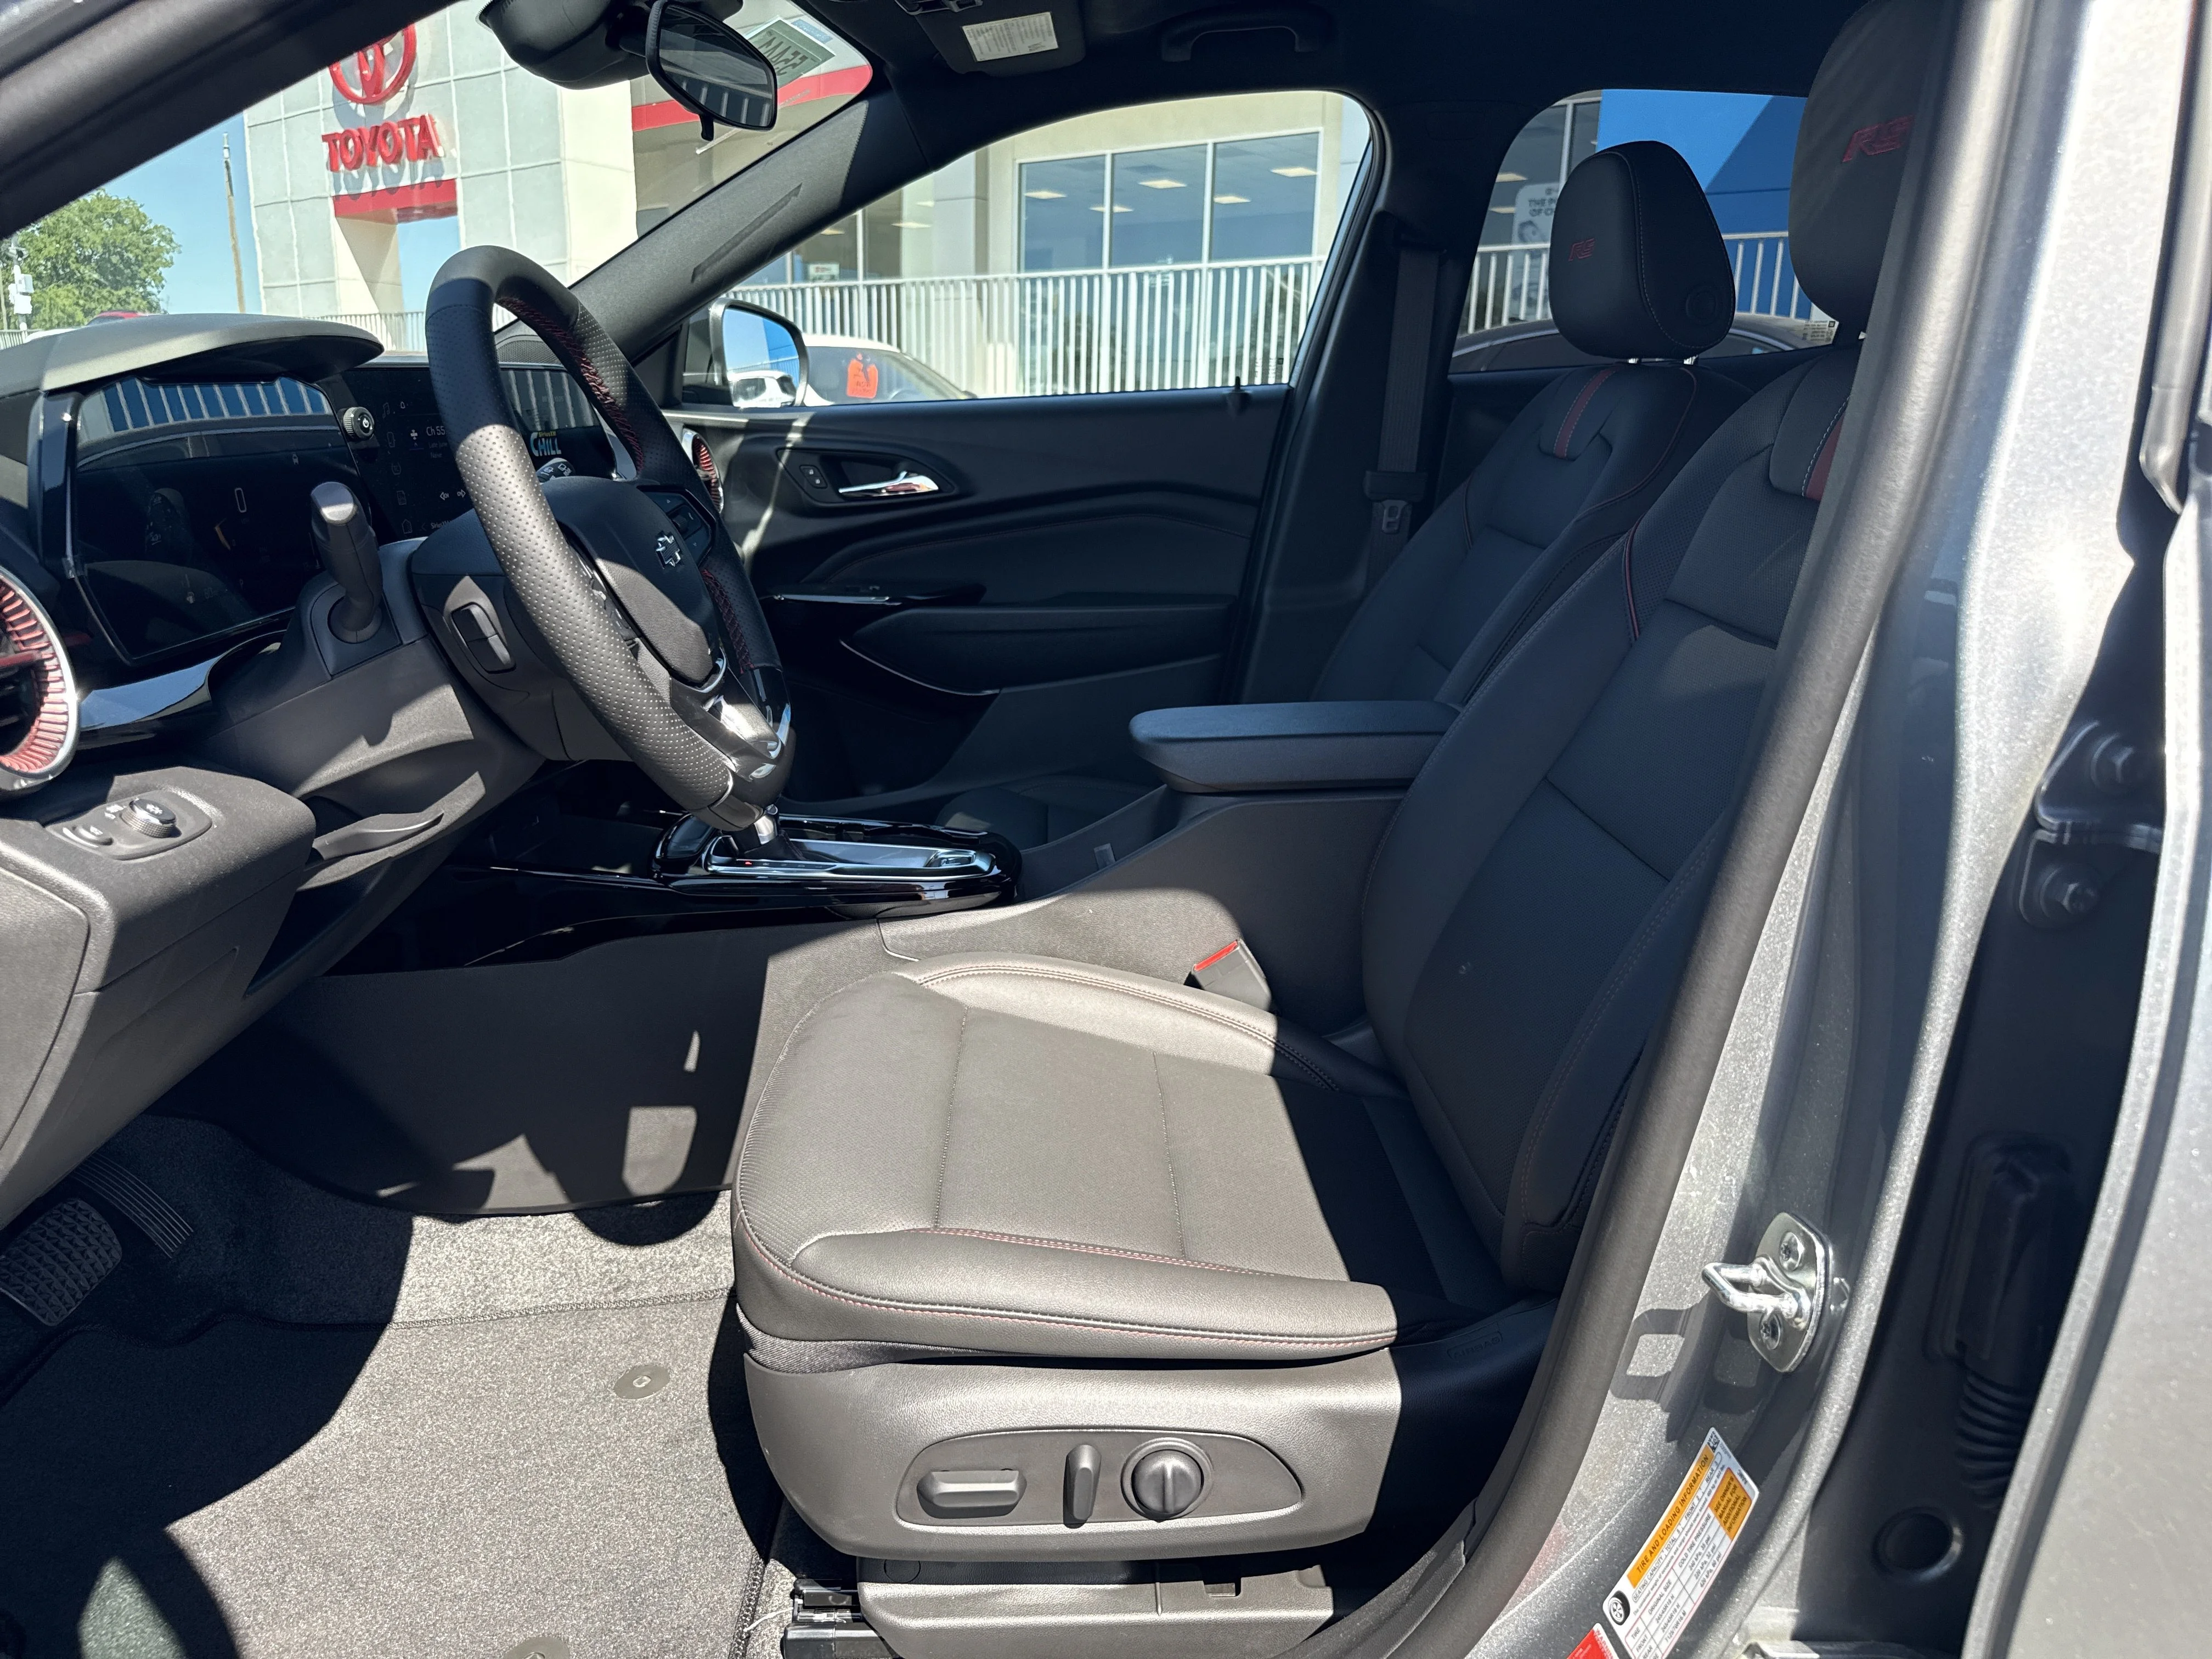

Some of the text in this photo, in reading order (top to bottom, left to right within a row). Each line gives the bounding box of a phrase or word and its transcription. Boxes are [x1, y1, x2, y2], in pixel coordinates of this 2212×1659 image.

[321, 114, 444, 172] TOYOTA
[1842, 113, 1916, 163] RS
[1568, 237, 1595, 262] RS
[426, 426, 445, 436] Ch 55
[530, 432, 562, 456] CHILL
[1718, 1483, 1738, 1519] MANUAL FOR
[1720, 1476, 1735, 1502] OWNER'S
[1637, 1454, 1709, 1573] TIRE AND LOADING INFORMATION
[1723, 1494, 1741, 1526] ADDITIONAL
[1726, 1496, 1748, 1532] INFORMATION
[1633, 1579, 1648, 1601] SEATING
[1647, 1555, 1663, 1580] CAPACITY
[1665, 1537, 1677, 1551] TOTAL
[1684, 1502, 1696, 1520] FRONT
[1705, 1467, 1716, 1483] REAR
[1631, 1513, 1711, 1639] TIRE ORIGINAL SIZE COLD TIRE PRESSURE
[1636, 1634, 1647, 1652] FRONT
